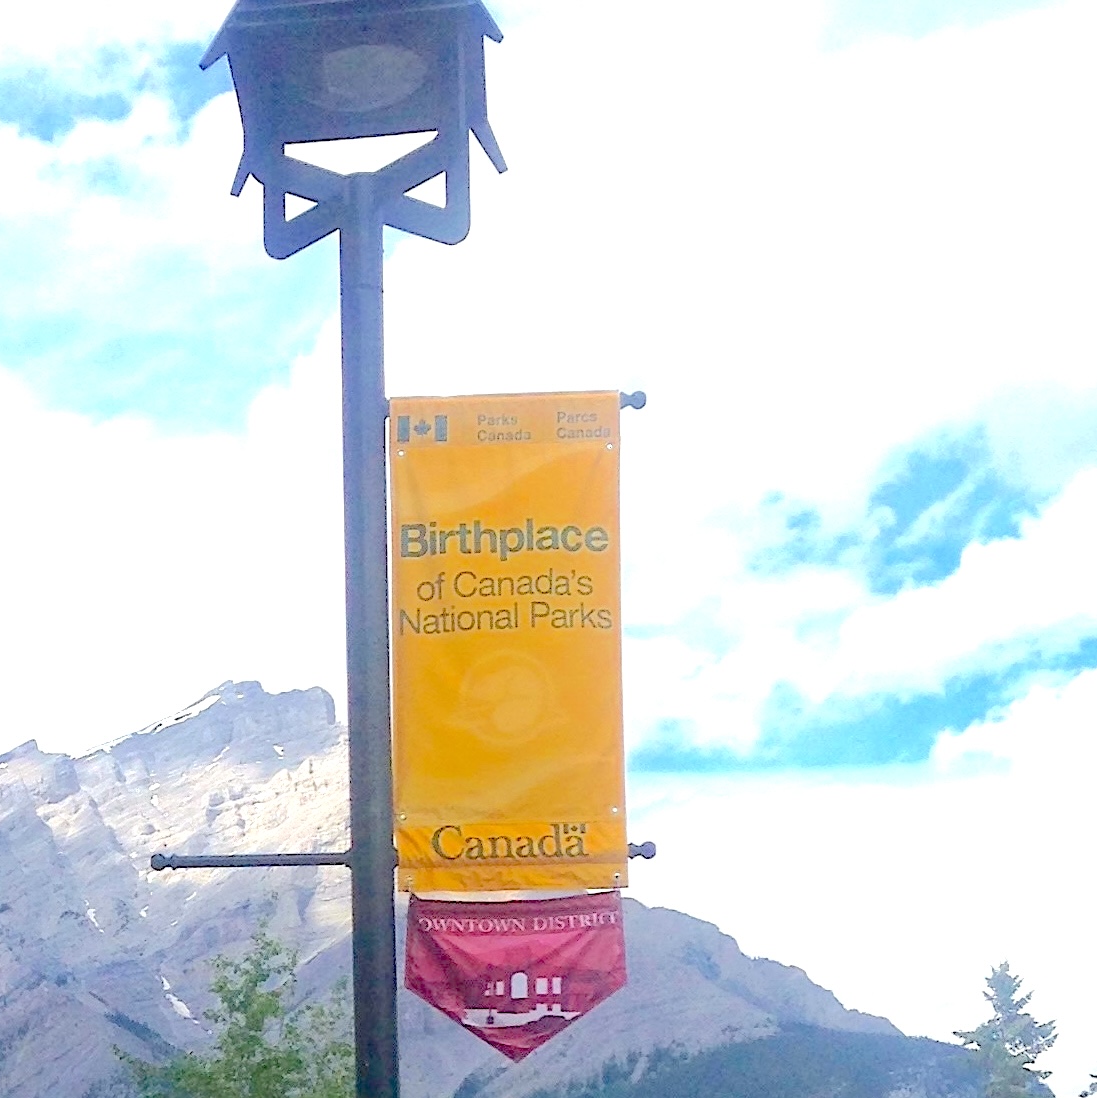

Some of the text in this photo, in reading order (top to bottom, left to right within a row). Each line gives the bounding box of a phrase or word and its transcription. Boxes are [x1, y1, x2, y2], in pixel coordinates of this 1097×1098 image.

[477, 414, 518, 426] Parks
[557, 411, 598, 424] Parcs
[477, 429, 532, 442] Canada
[556, 426, 611, 439] Canada
[400, 518, 609, 562] Birthplace
[416, 568, 594, 602] of Canada's
[399, 601, 613, 636] National Parks
[431, 823, 590, 861] Canada
[418, 916, 526, 933] OWNTOWN
